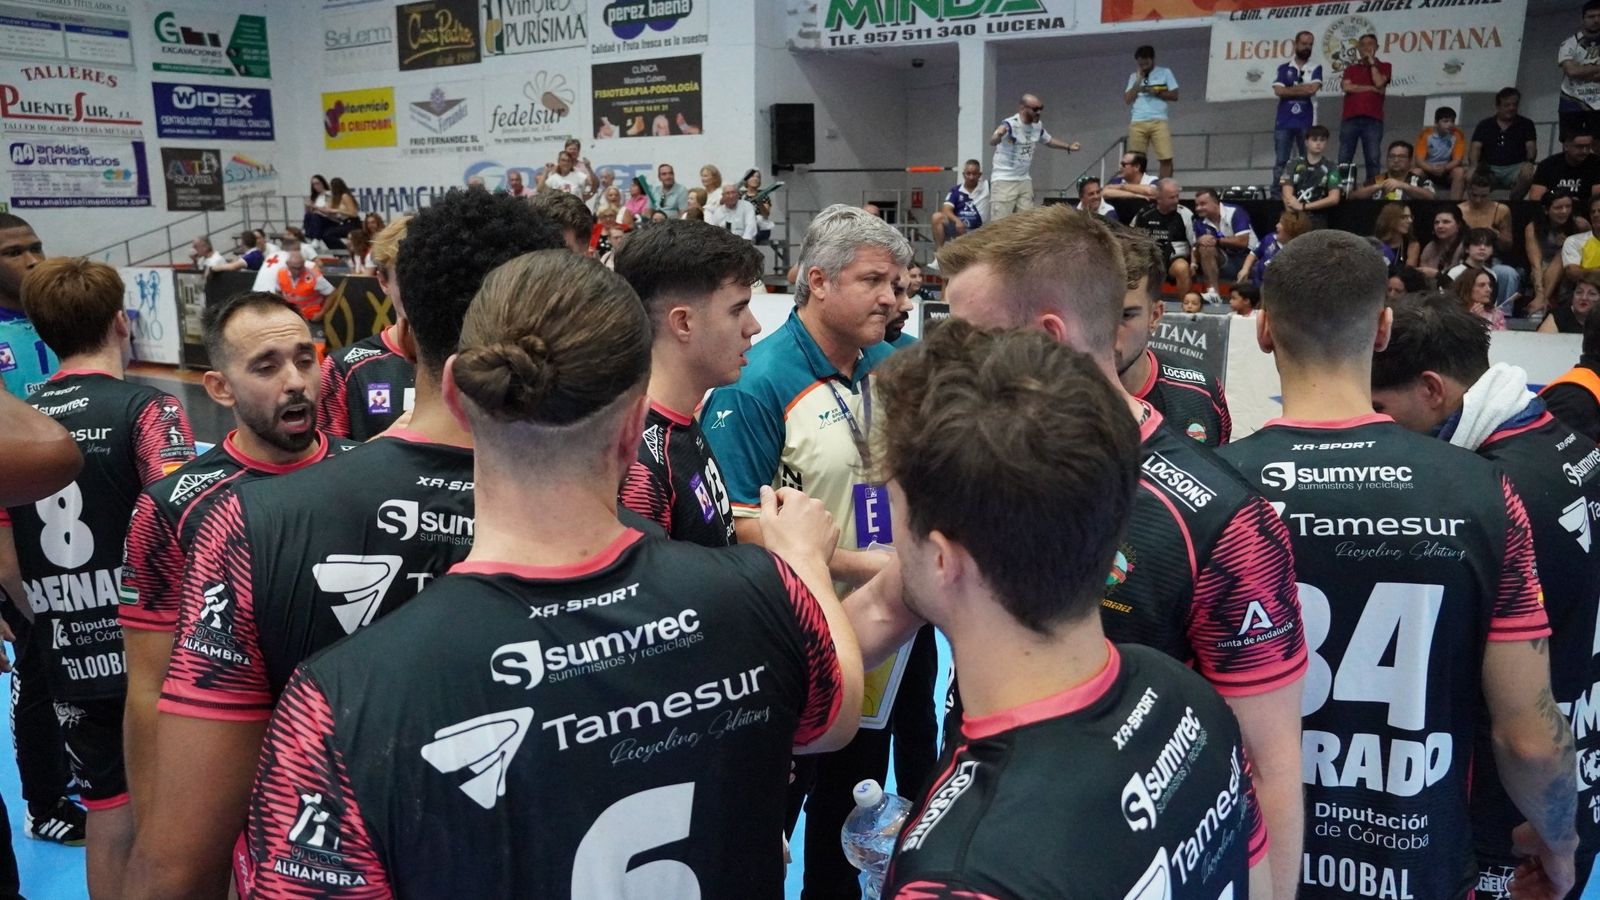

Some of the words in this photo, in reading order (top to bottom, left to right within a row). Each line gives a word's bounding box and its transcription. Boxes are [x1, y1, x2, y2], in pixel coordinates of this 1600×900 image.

[607, 4, 645, 27] perez
[648, 0, 690, 18] baena
[1267, 6, 1310, 20] PUENTE
[1315, 3, 1350, 16] GENIL
[505, 14, 587, 47] PURÍSIMA
[828, 35, 859, 46] TLF.
[863, 30, 897, 43] 957
[901, 28, 933, 42] 511
[936, 24, 976, 38] 340
[986, 17, 1066, 34] LUCENA
[1225, 39, 1296, 60] LEGIO
[1383, 26, 1502, 53] PONTANA
[592, 41, 615, 54] Calidad
[21, 65, 118, 88] TALLERES
[172, 85, 252, 110] WIDEX
[3, 122, 36, 131] TALLER
[489, 102, 567, 133] fedelsur
[1147, 340, 1180, 354] PUENTE
[1180, 346, 1205, 360] GENIL
[1152, 322, 1208, 350] TANA
[1162, 366, 1206, 382] LOCSONS
[416, 475, 475, 492] XA-SP
[1141, 455, 1213, 508] LOCSONS
[1297, 465, 1413, 484] sumyrec
[1297, 481, 1355, 491] suministros
[1365, 480, 1414, 490] reciclajes
[174, 473, 228, 506] ESMONSUR
[35, 480, 94, 569] 8
[866, 498, 880, 534] E
[1289, 513, 1466, 537] Tamesur
[71, 617, 122, 634] Diputac
[76, 634, 93, 646] de
[95, 628, 124, 643] Córd
[1217, 639, 1242, 649] Junta
[1243, 637, 1256, 646] de
[1256, 621, 1294, 642] Andalucía
[183, 638, 251, 666] ALHAMBRA
[545, 608, 701, 672] sumyrec
[67, 651, 127, 681] GLOOB
[548, 653, 626, 684] suministros
[640, 630, 705, 657] reciclajes
[541, 665, 766, 751] Tamesur
[609, 726, 704, 768] Recycling
[707, 705, 771, 740] Solutions
[1302, 729, 1453, 797] RADO
[1315, 802, 1428, 830] Diputación
[1315, 821, 1342, 837] de
[1348, 824, 1429, 851] Córdoba
[274, 859, 368, 886] ALHAMBRA
[1303, 852, 1415, 900] LOOBAL
